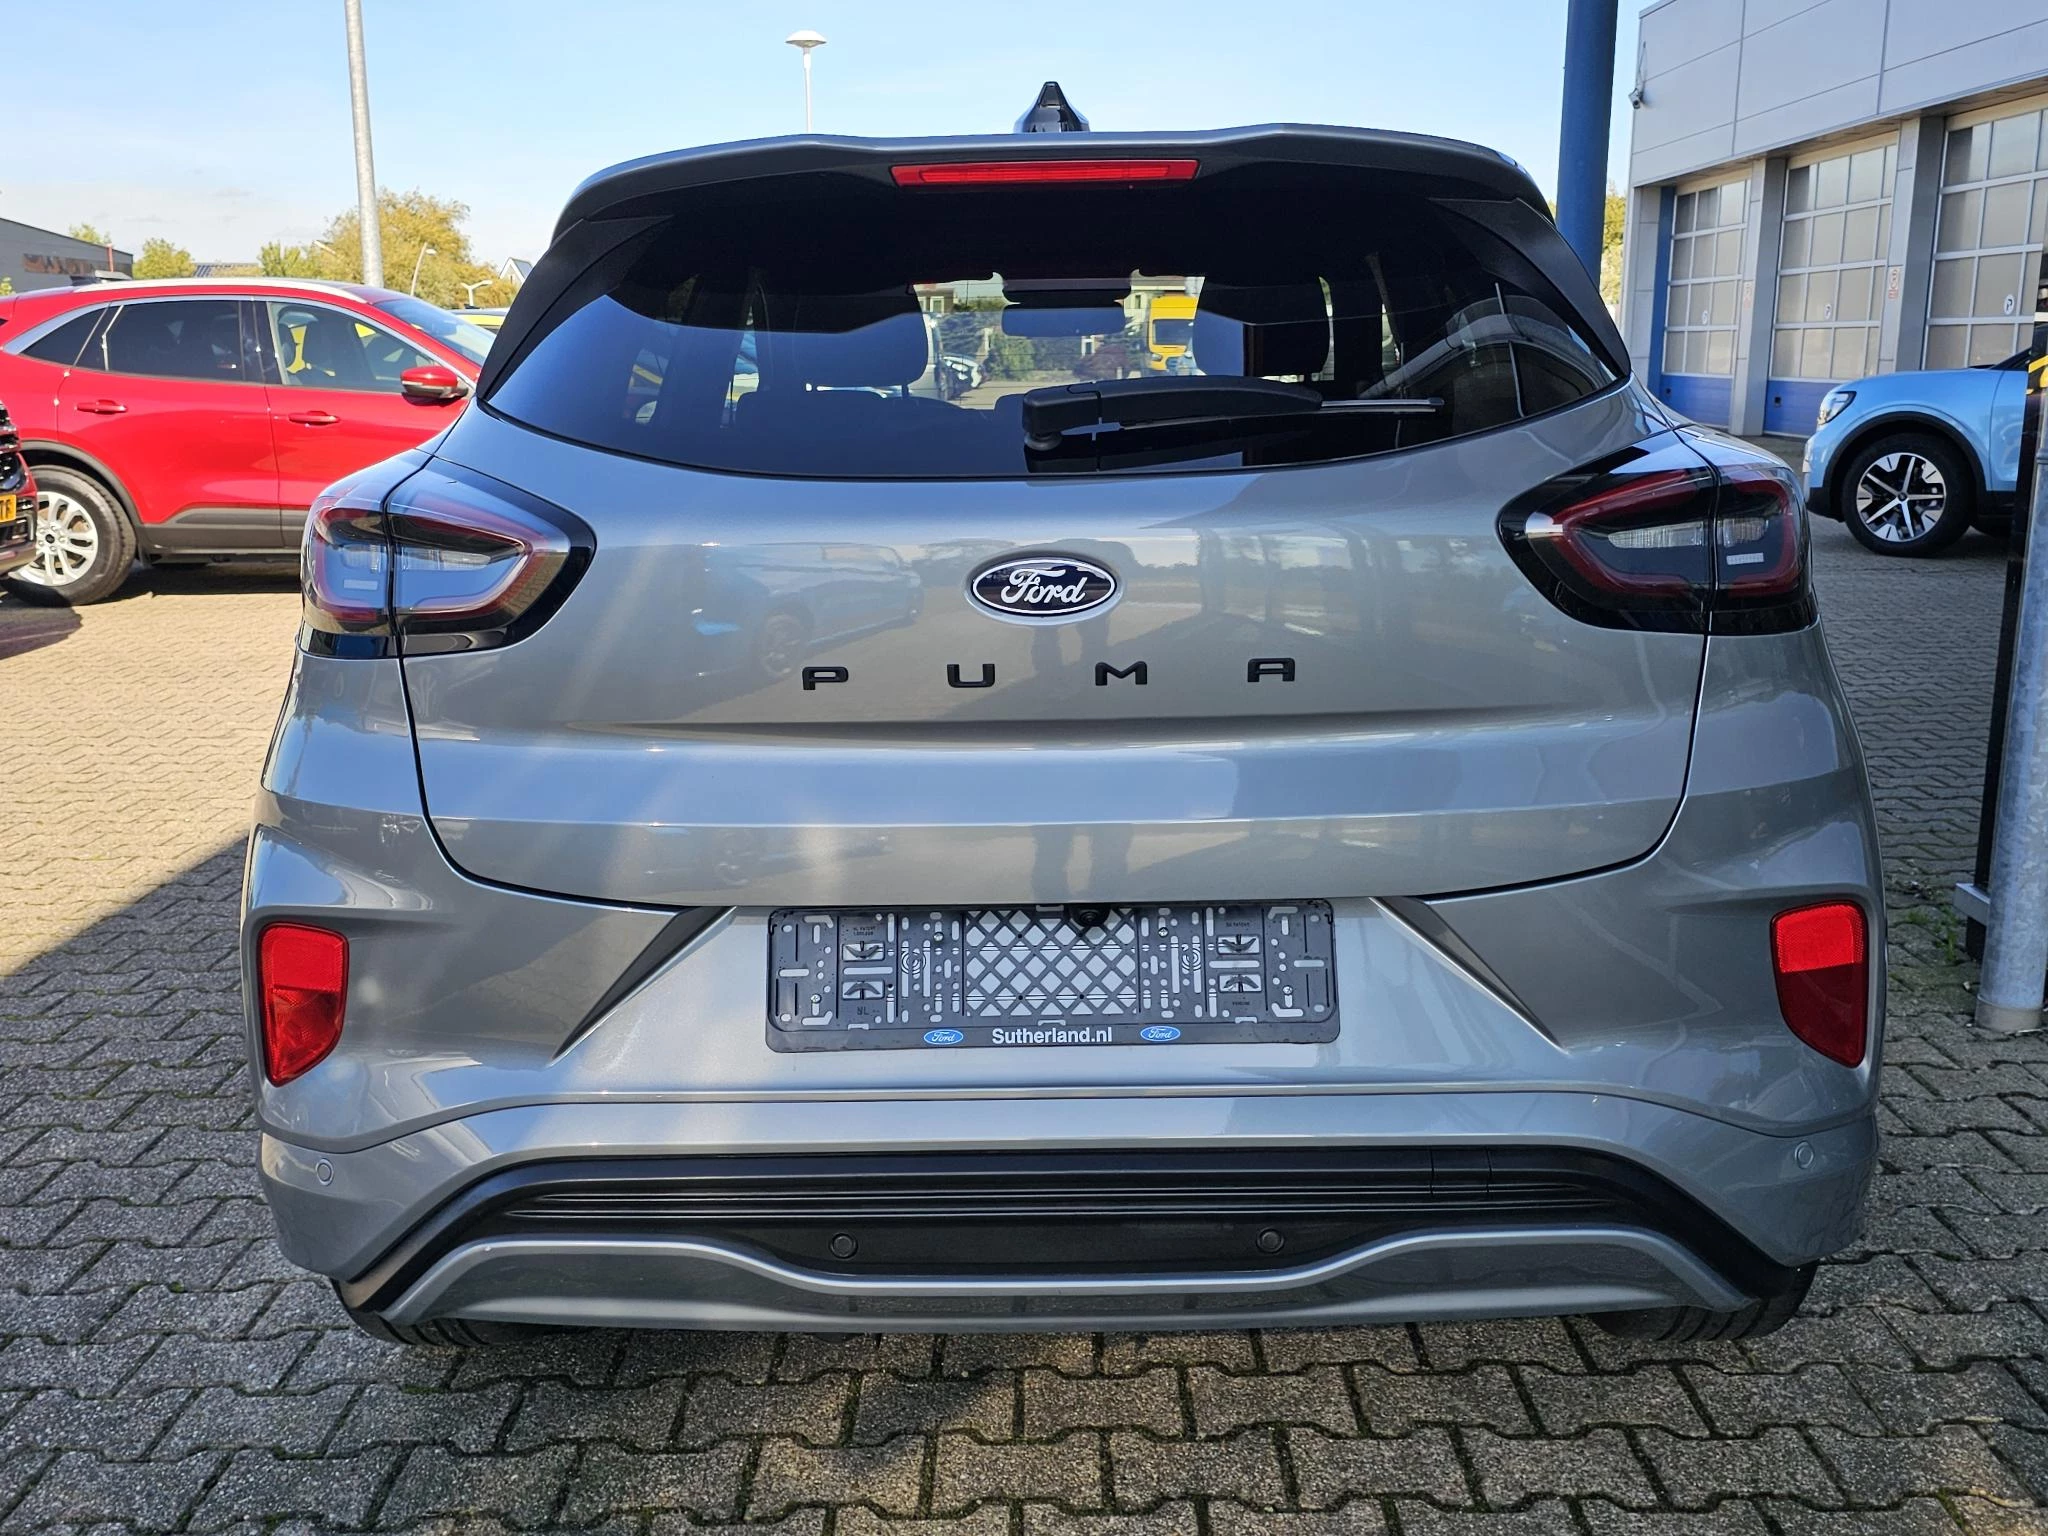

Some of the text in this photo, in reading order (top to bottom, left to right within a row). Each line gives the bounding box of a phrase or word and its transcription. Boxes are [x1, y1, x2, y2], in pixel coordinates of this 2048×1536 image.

[1001, 568, 1088, 605] Ford
[802, 657, 1296, 691] PUMA
[931, 1031, 955, 1043] Ford
[992, 1027, 1112, 1044] Sutherland.nl
[1148, 1028, 1172, 1040] Ford
